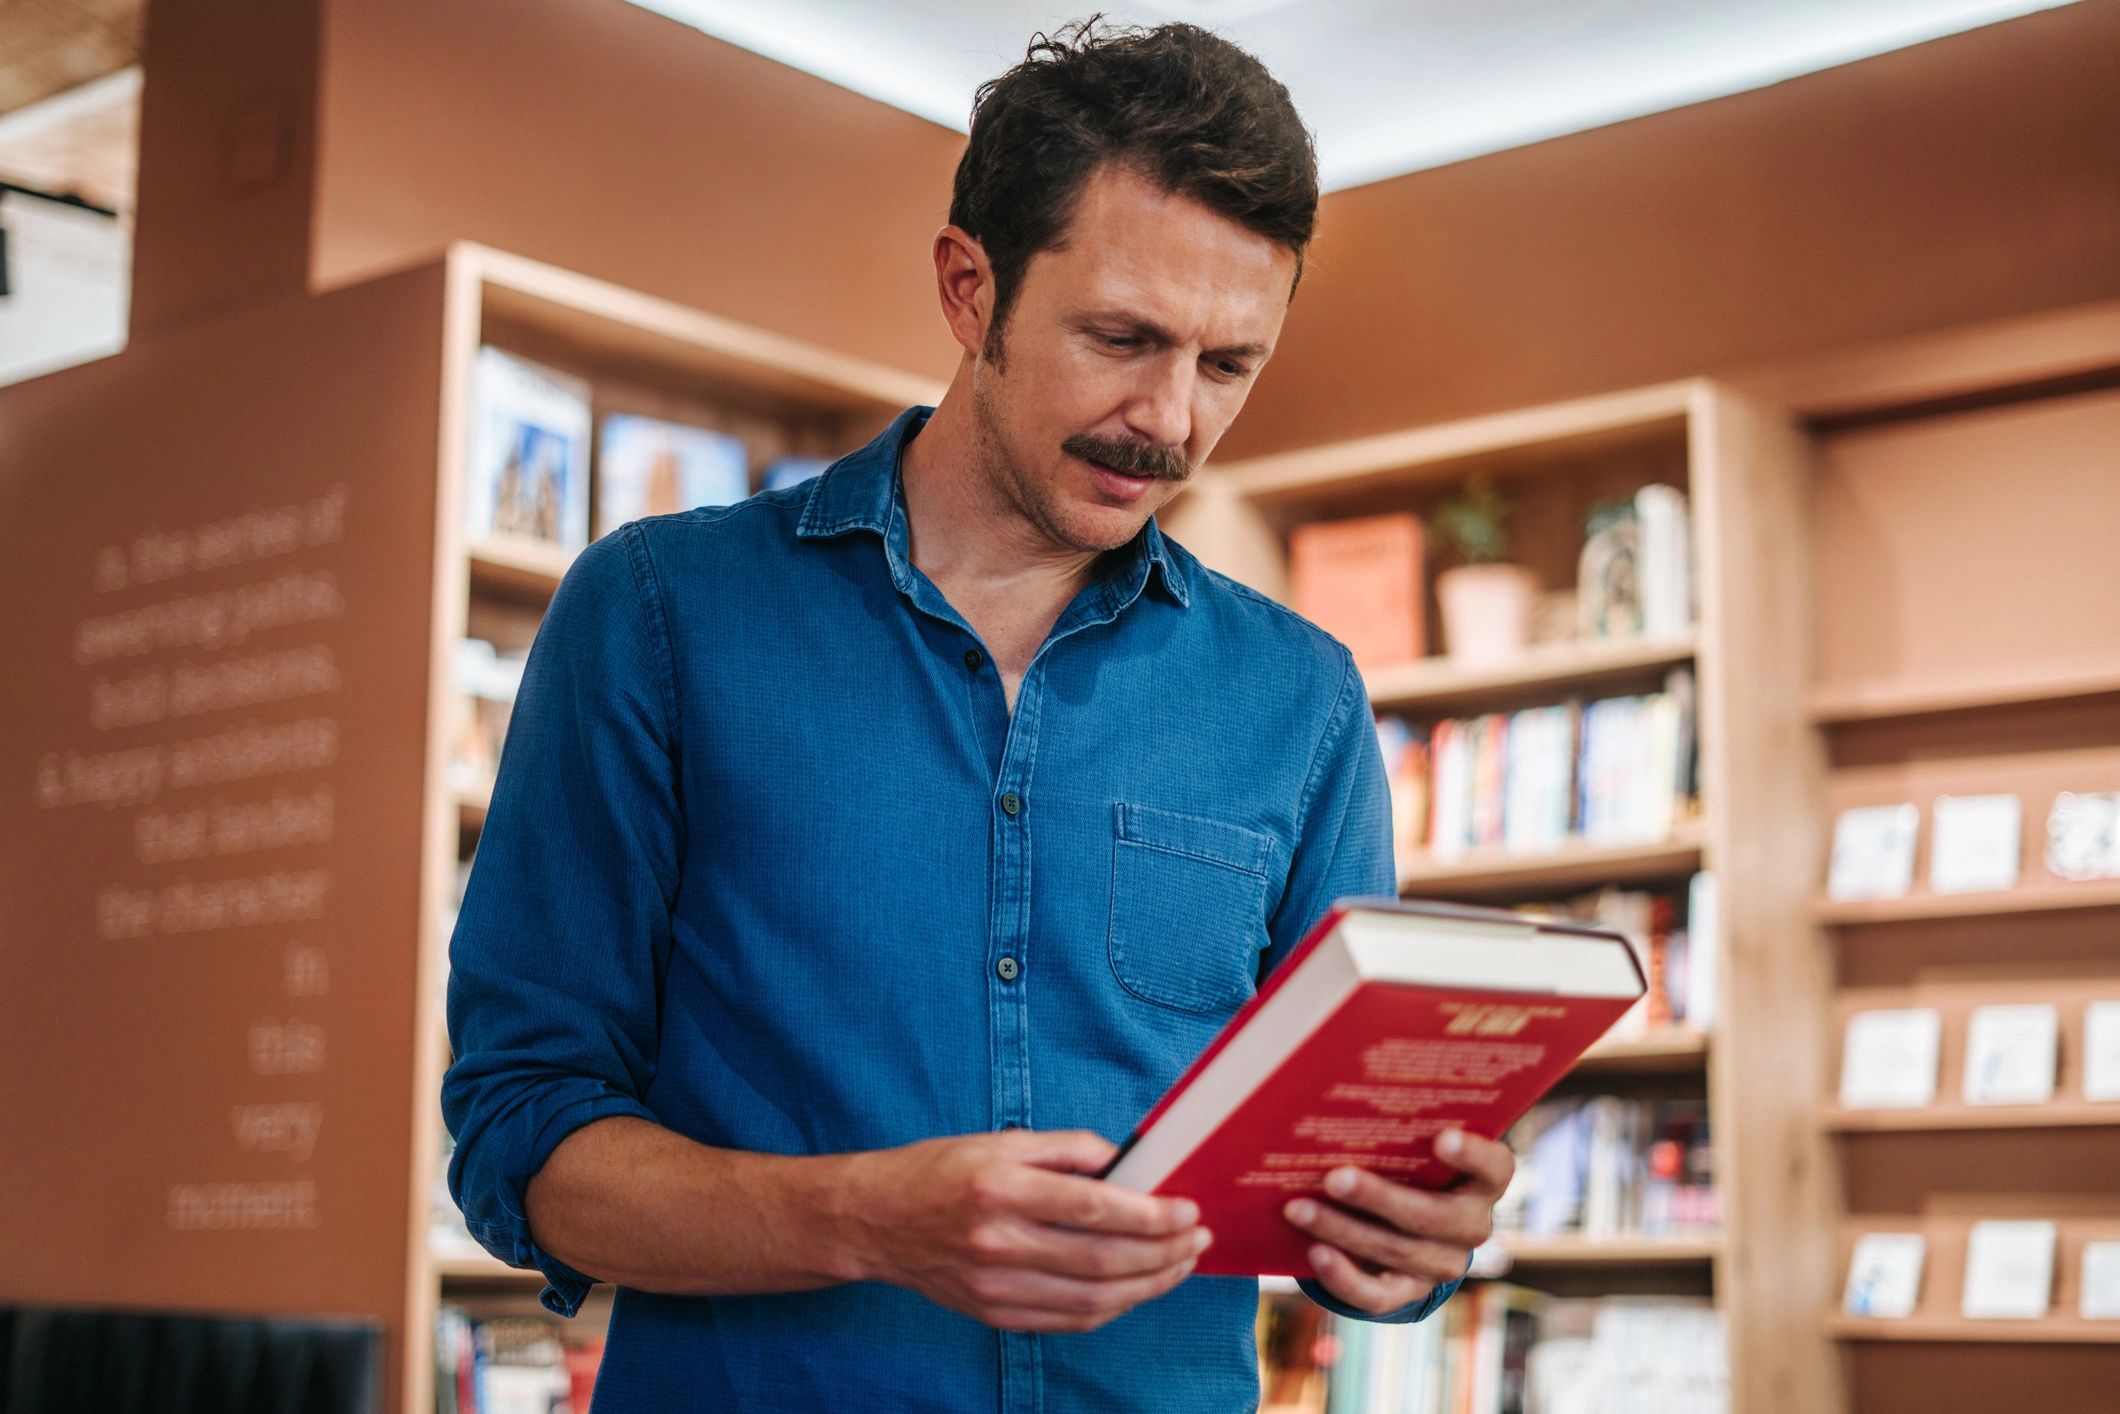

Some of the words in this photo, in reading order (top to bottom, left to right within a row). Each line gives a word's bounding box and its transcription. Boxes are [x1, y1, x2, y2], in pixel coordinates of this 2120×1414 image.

[133, 532, 189, 581] the
[195, 509, 297, 569] series
[304, 486, 344, 545] of
[136, 808, 204, 862] that
[98, 886, 151, 938] the
[155, 872, 329, 931] character
[287, 943, 328, 996] in
[250, 1019, 327, 1074] this
[234, 1103, 322, 1161] very
